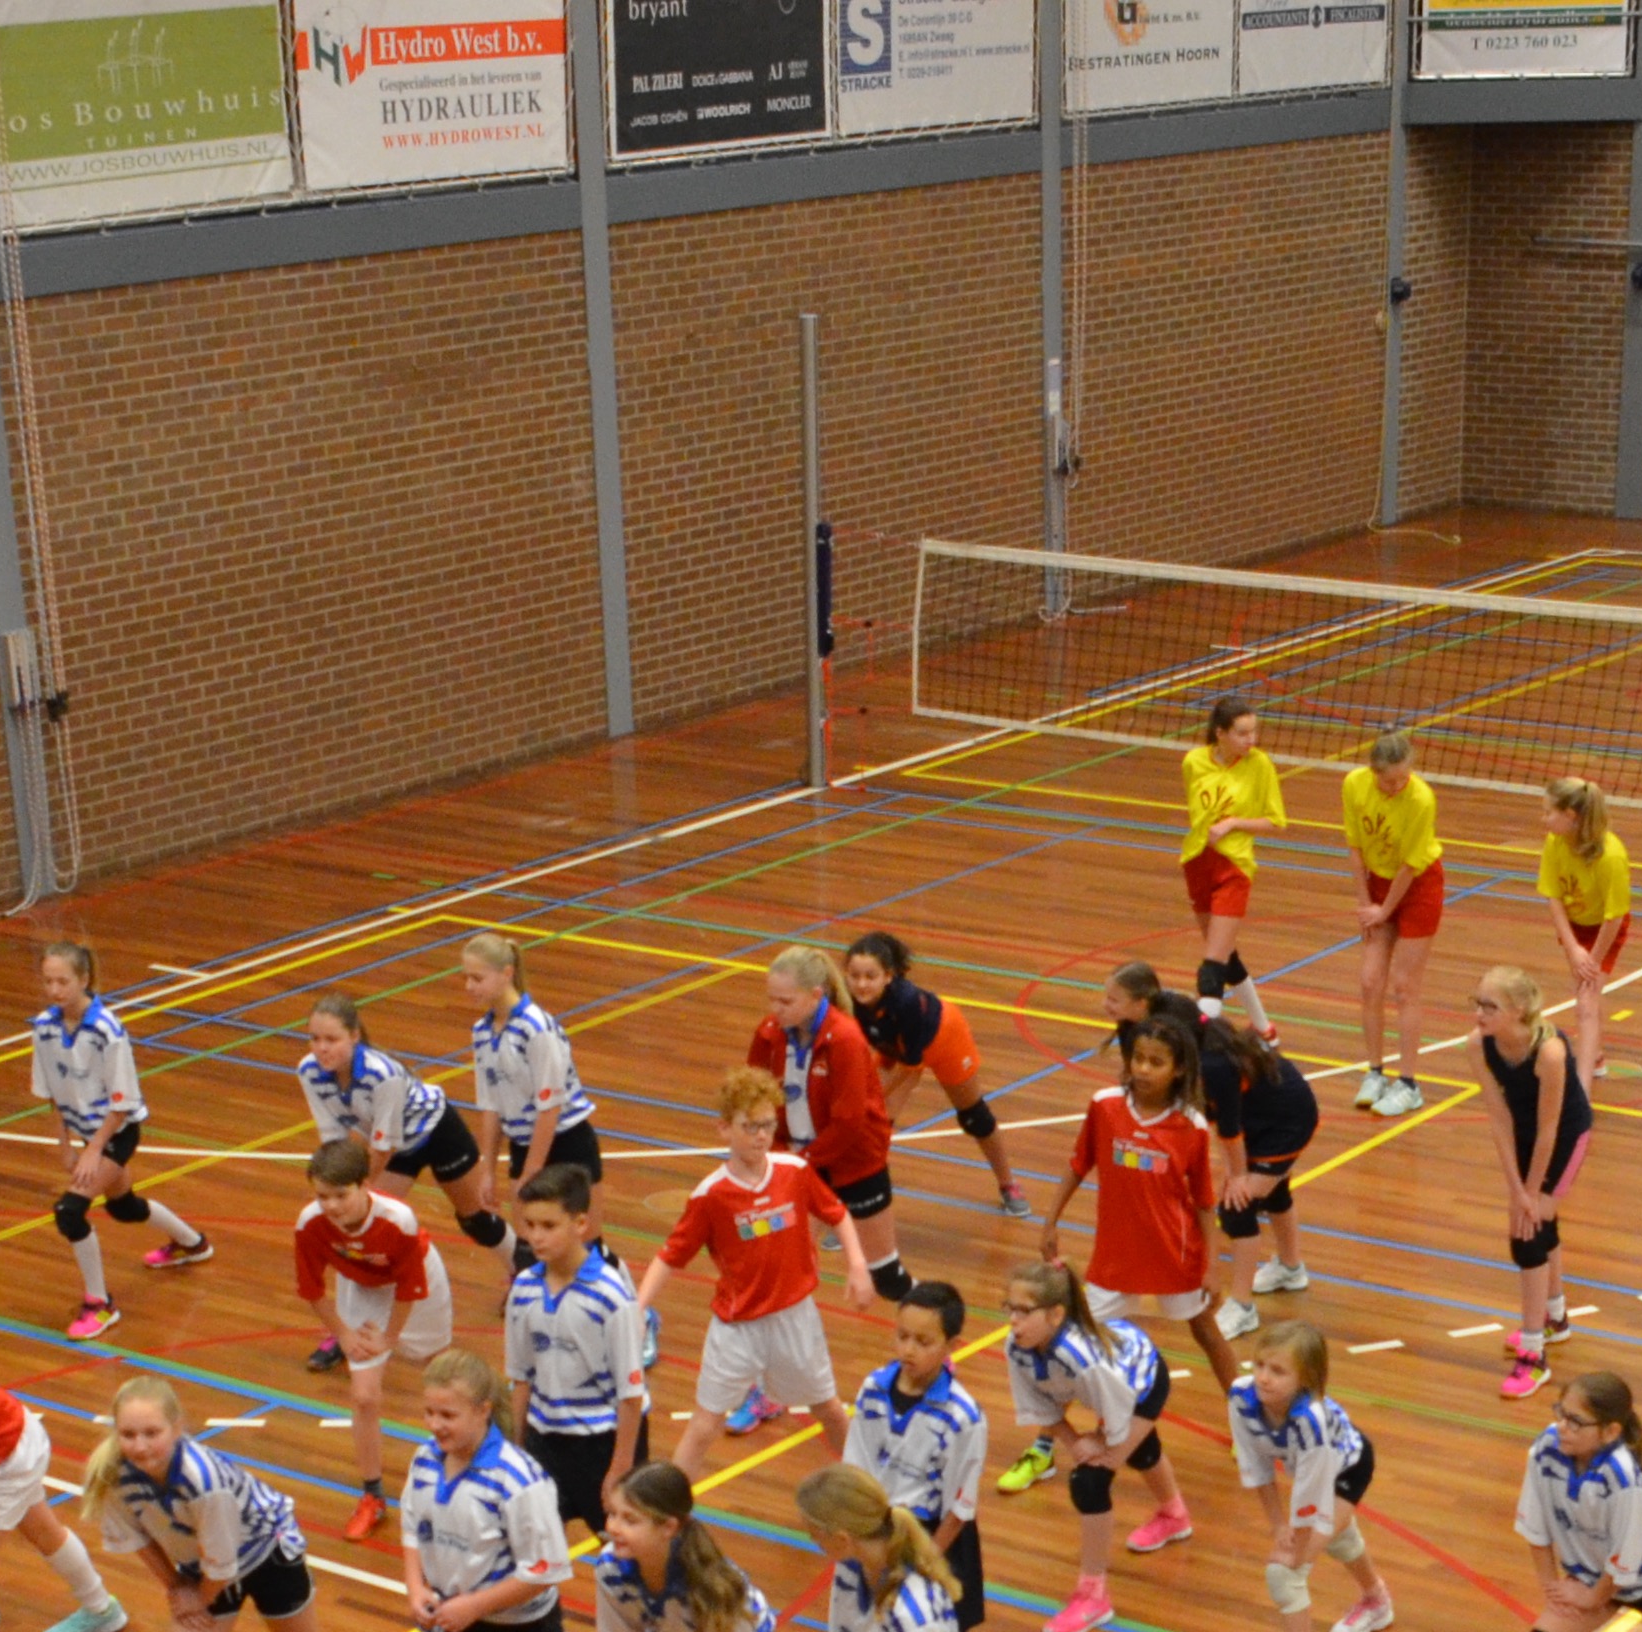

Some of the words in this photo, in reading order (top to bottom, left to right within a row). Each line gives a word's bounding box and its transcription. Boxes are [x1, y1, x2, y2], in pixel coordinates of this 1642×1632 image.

[1245, 10, 1308, 26] ACCOUNTANTS
[1330, 6, 1380, 21] FISCALISTEN
[377, 31, 446, 64] Hydro
[451, 27, 500, 55] West
[507, 25, 543, 52] b.v.
[1486, 36, 1519, 50] 0223
[1524, 35, 1548, 49] 760
[1553, 34, 1578, 47] 023
[840, 76, 892, 93] STRACKE
[74, 86, 281, 127] Bouwhuis
[380, 90, 542, 124] HYDRAULIEK
[766, 95, 812, 112] MONCLER
[87, 127, 198, 149] TUINEN
[382, 123, 545, 150] WWW.HYDROWEST.NL
